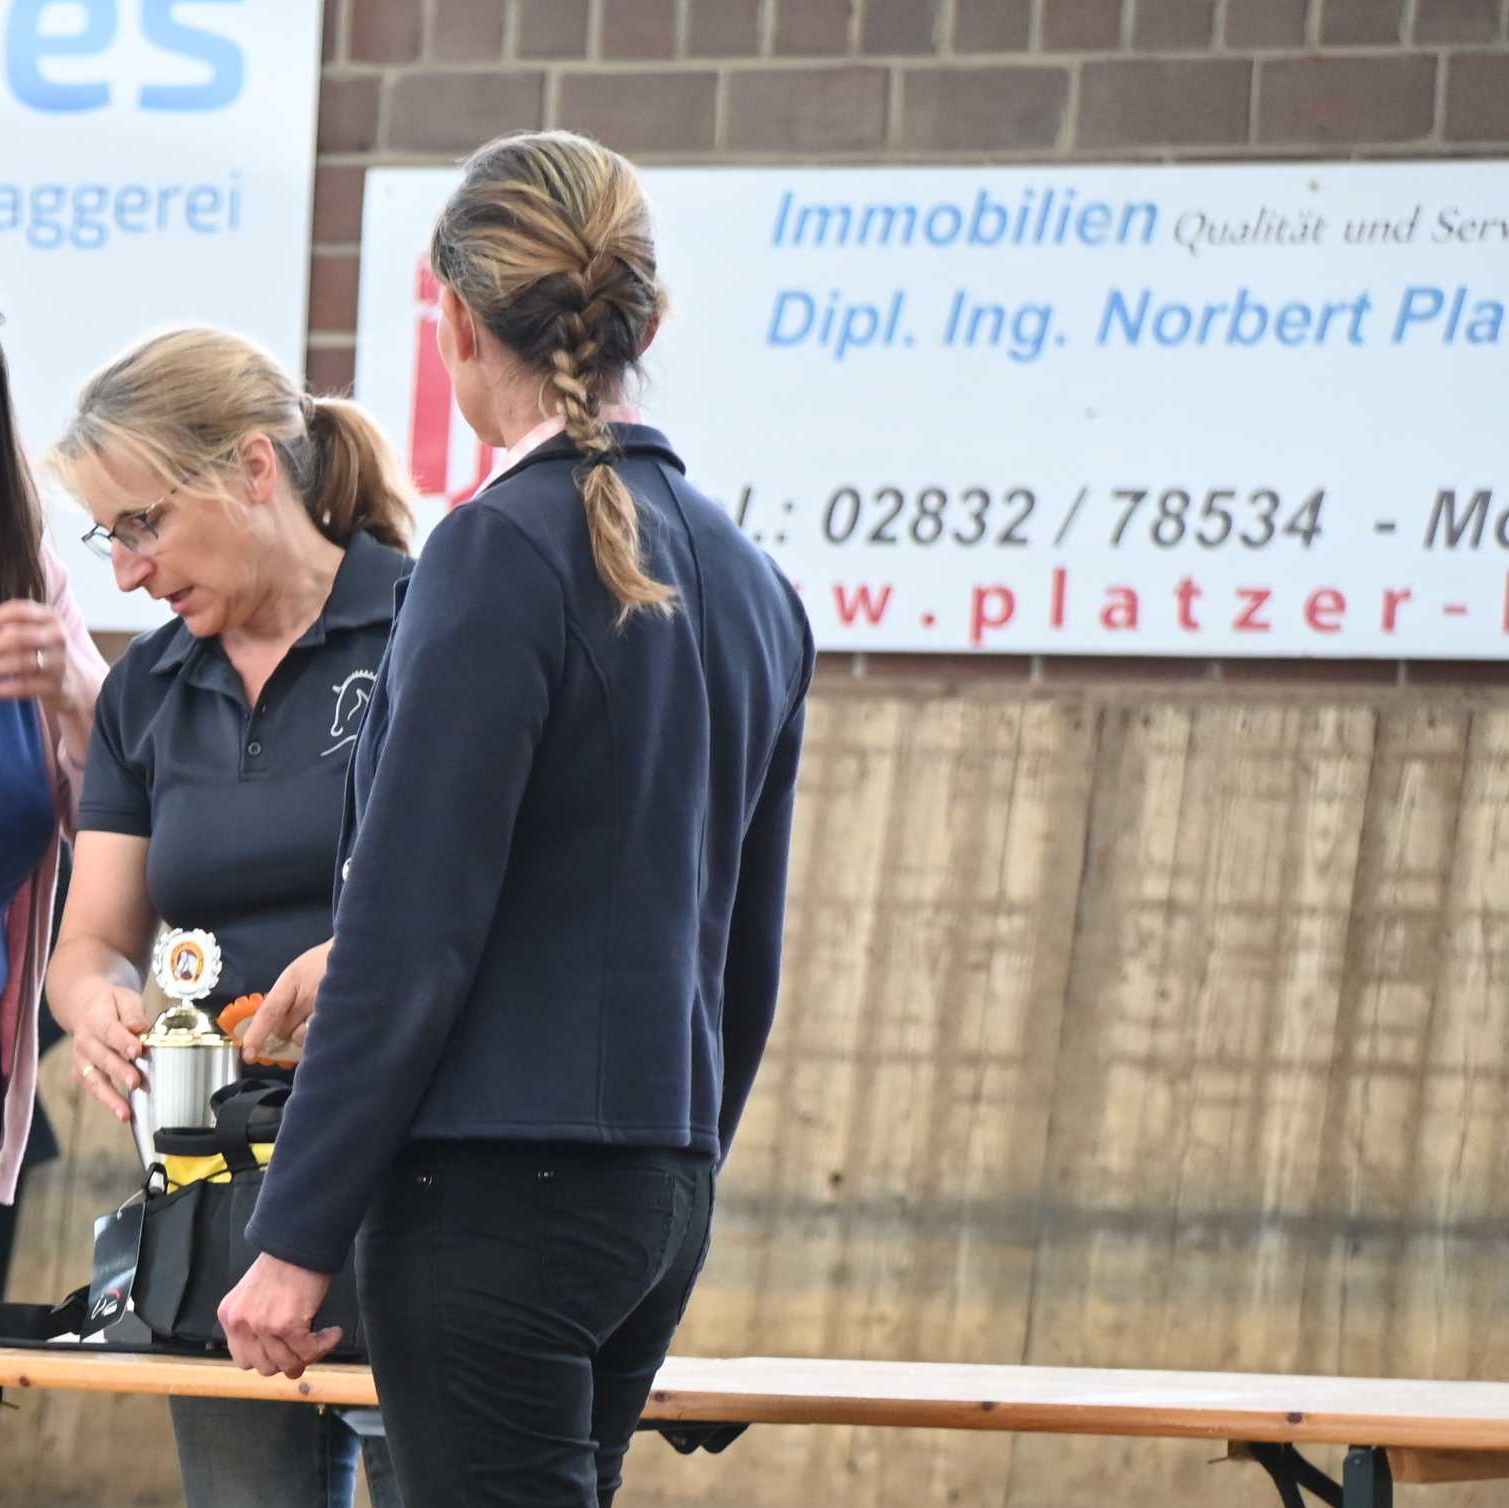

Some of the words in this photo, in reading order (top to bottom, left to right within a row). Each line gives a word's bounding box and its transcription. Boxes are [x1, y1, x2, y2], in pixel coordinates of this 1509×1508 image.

[771, 187, 1162, 248] Immobilien
[1173, 205, 1326, 257] Qualität
[1343, 203, 1423, 244] und
[765, 287, 917, 362] Dipl.
[941, 287, 1070, 364] Ing.
[1096, 288, 1374, 348] Norbert
[1390, 284, 1507, 347] Pla
[822, 486, 1037, 547] 02832
[1111, 488, 1326, 550] 78534
